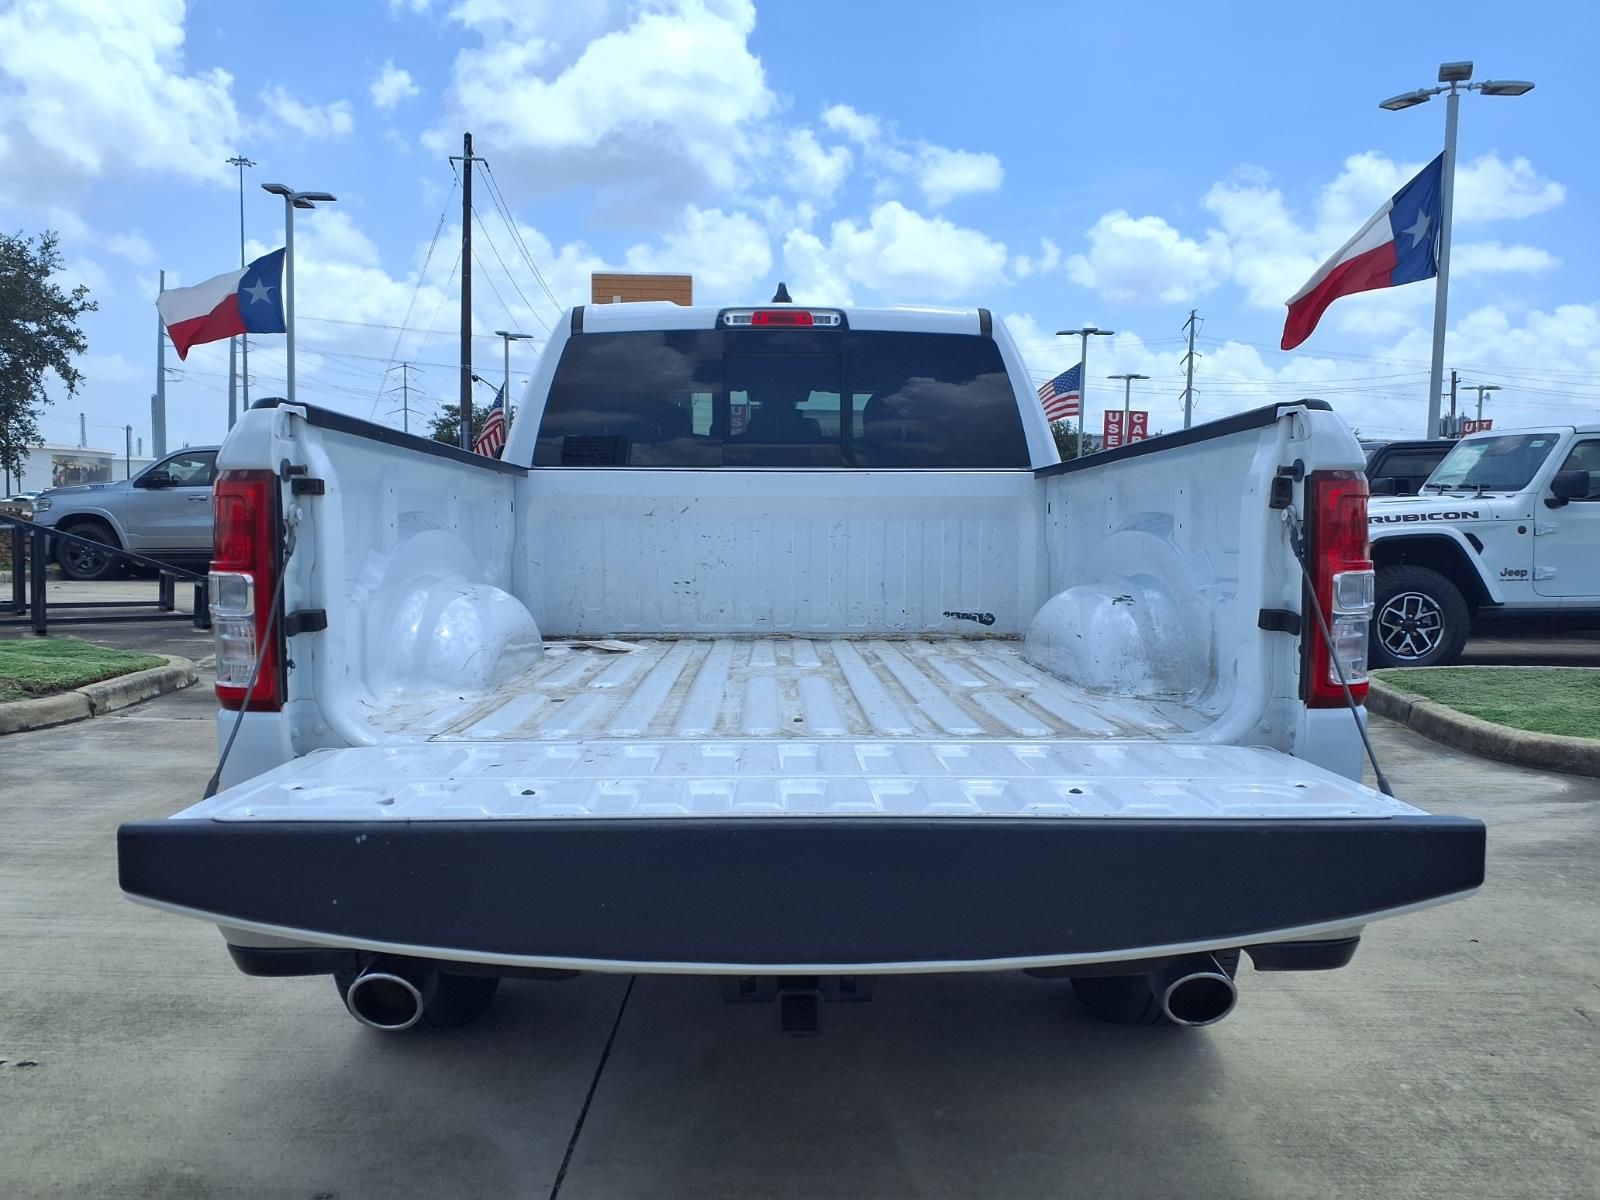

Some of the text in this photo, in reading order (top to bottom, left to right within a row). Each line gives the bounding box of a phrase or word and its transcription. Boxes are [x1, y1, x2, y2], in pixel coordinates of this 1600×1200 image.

[1108, 412, 1119, 449] USE
[1368, 511, 1480, 524] RUBICON
[1499, 567, 1528, 578] Jeep
